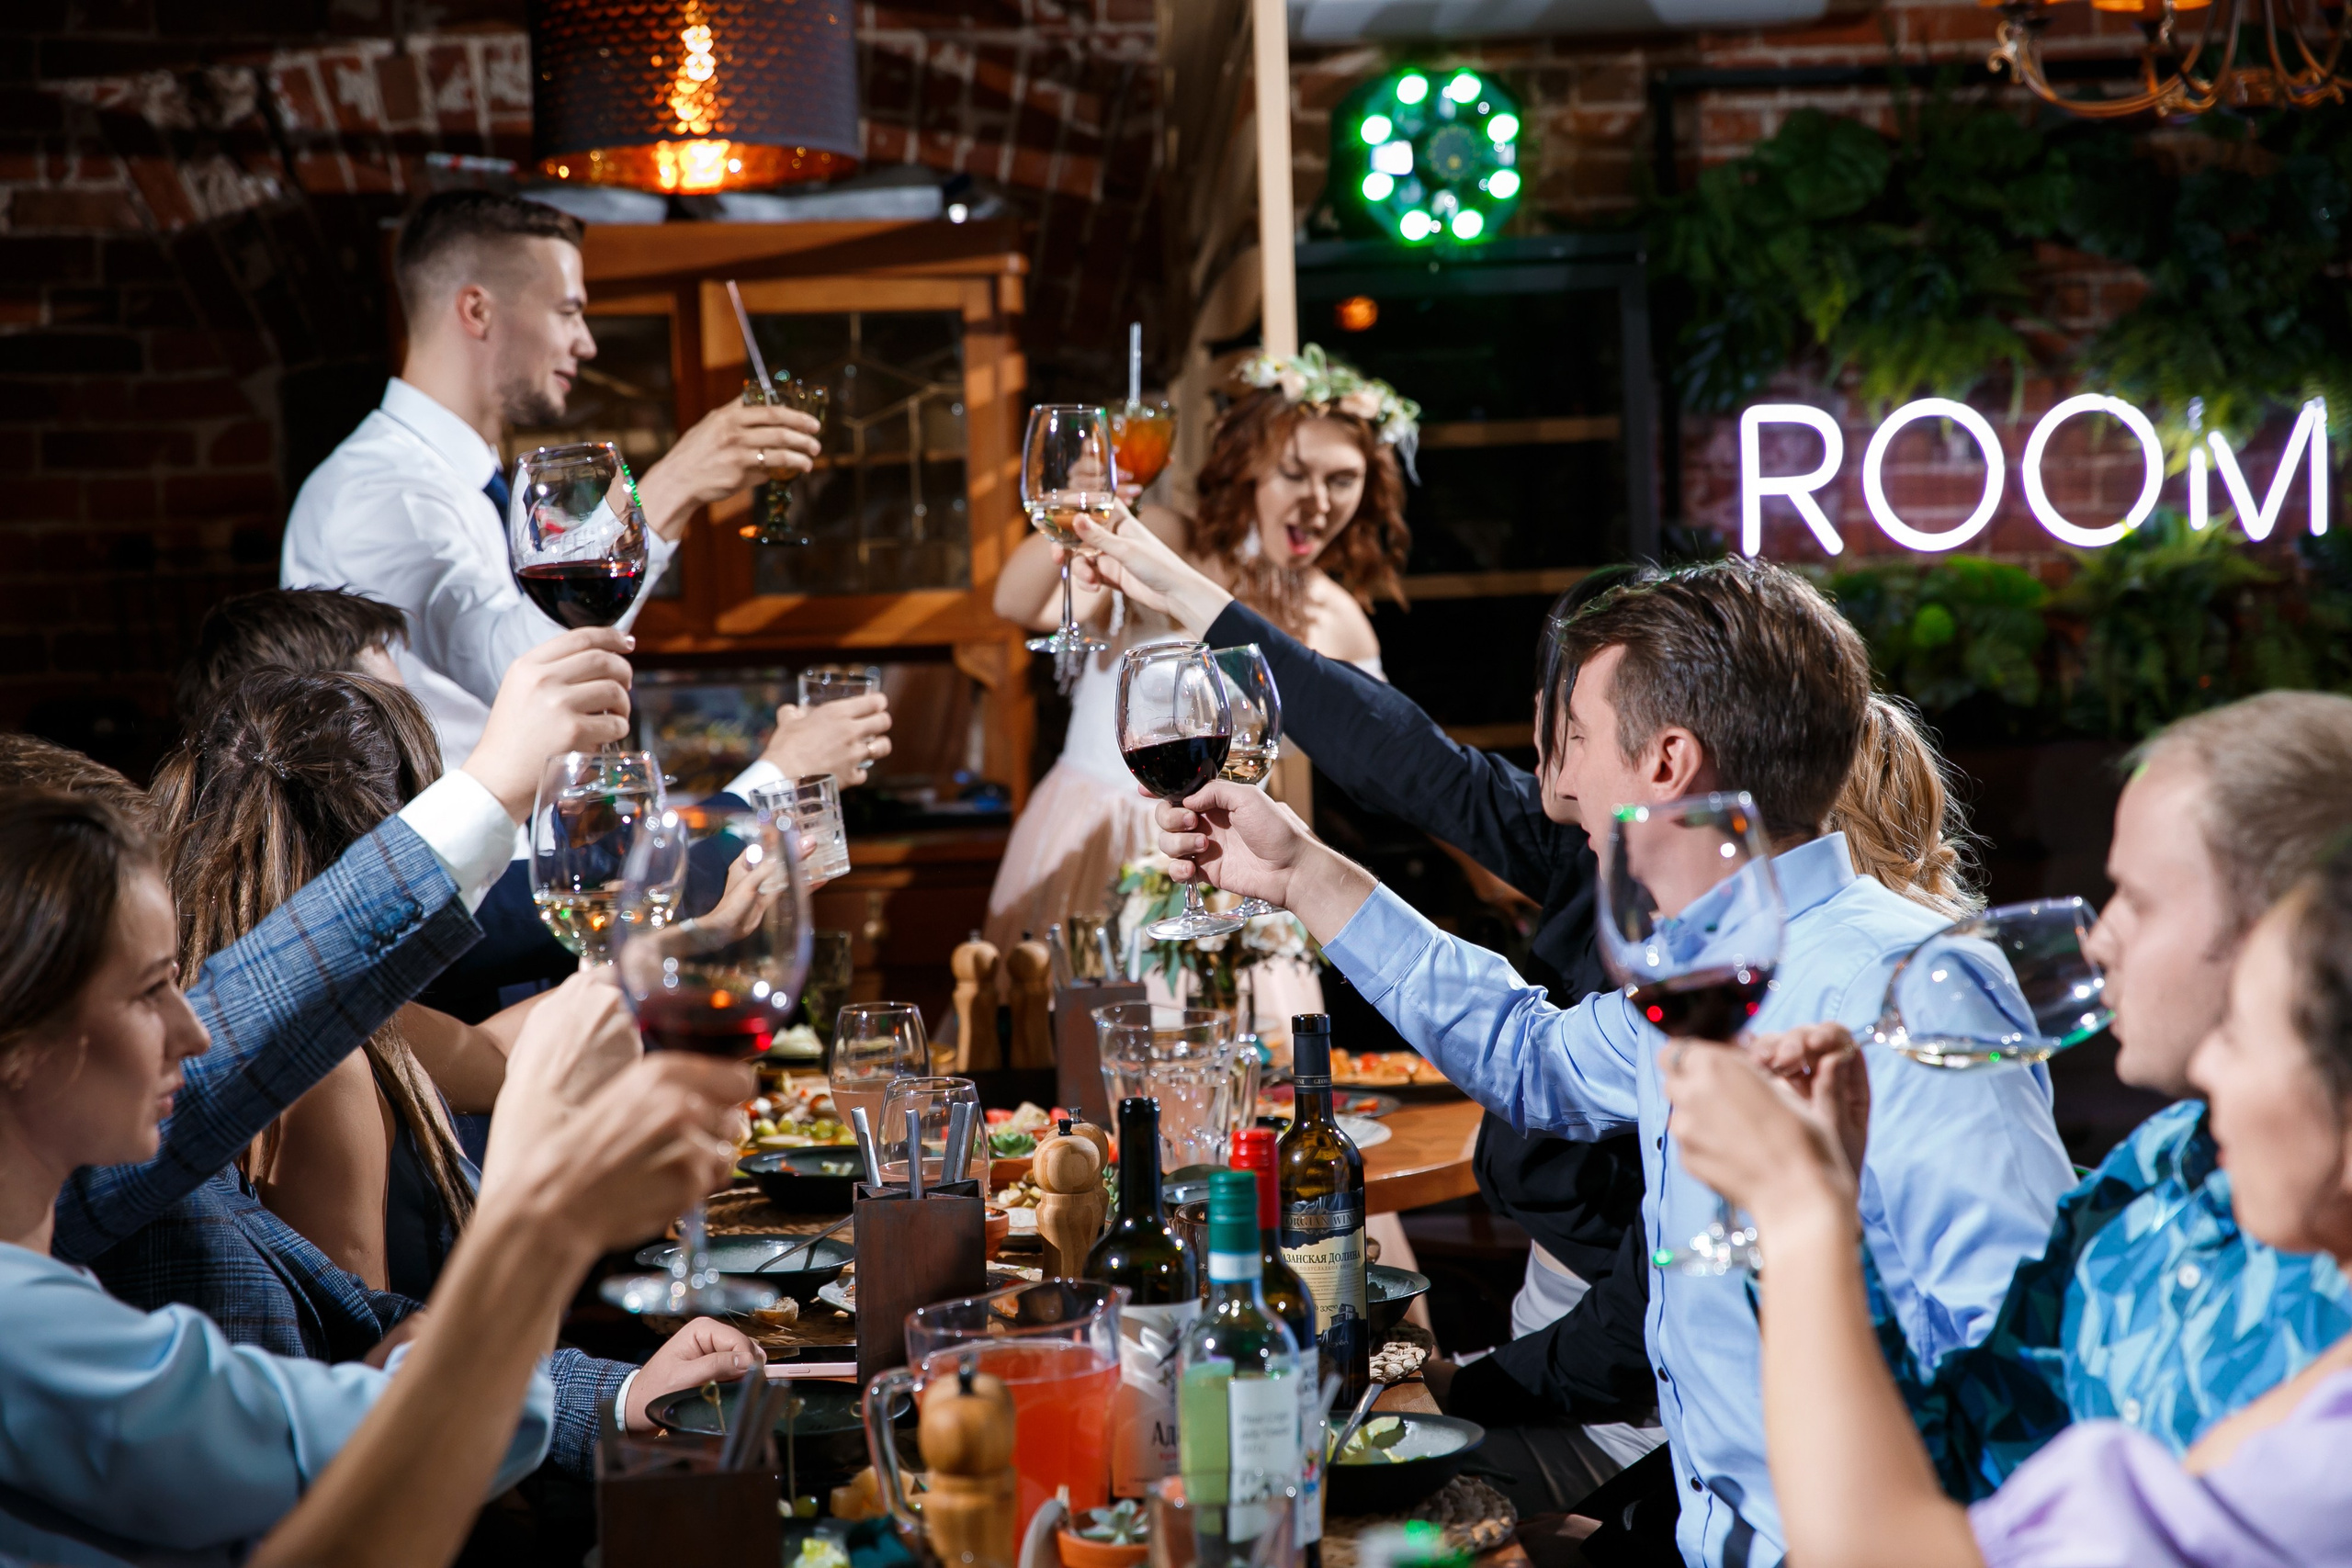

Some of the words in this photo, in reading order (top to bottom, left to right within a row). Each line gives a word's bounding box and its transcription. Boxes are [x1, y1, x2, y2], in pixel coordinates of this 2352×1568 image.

[1740, 392, 2328, 557] ROOM
[1285, 1216, 1329, 1226] ORGIAN
[1333, 1214, 1355, 1225] WIN
[1282, 1253, 1327, 1264] АЗАНСКАЯ
[1329, 1249, 1361, 1265] ДОЛИНА
